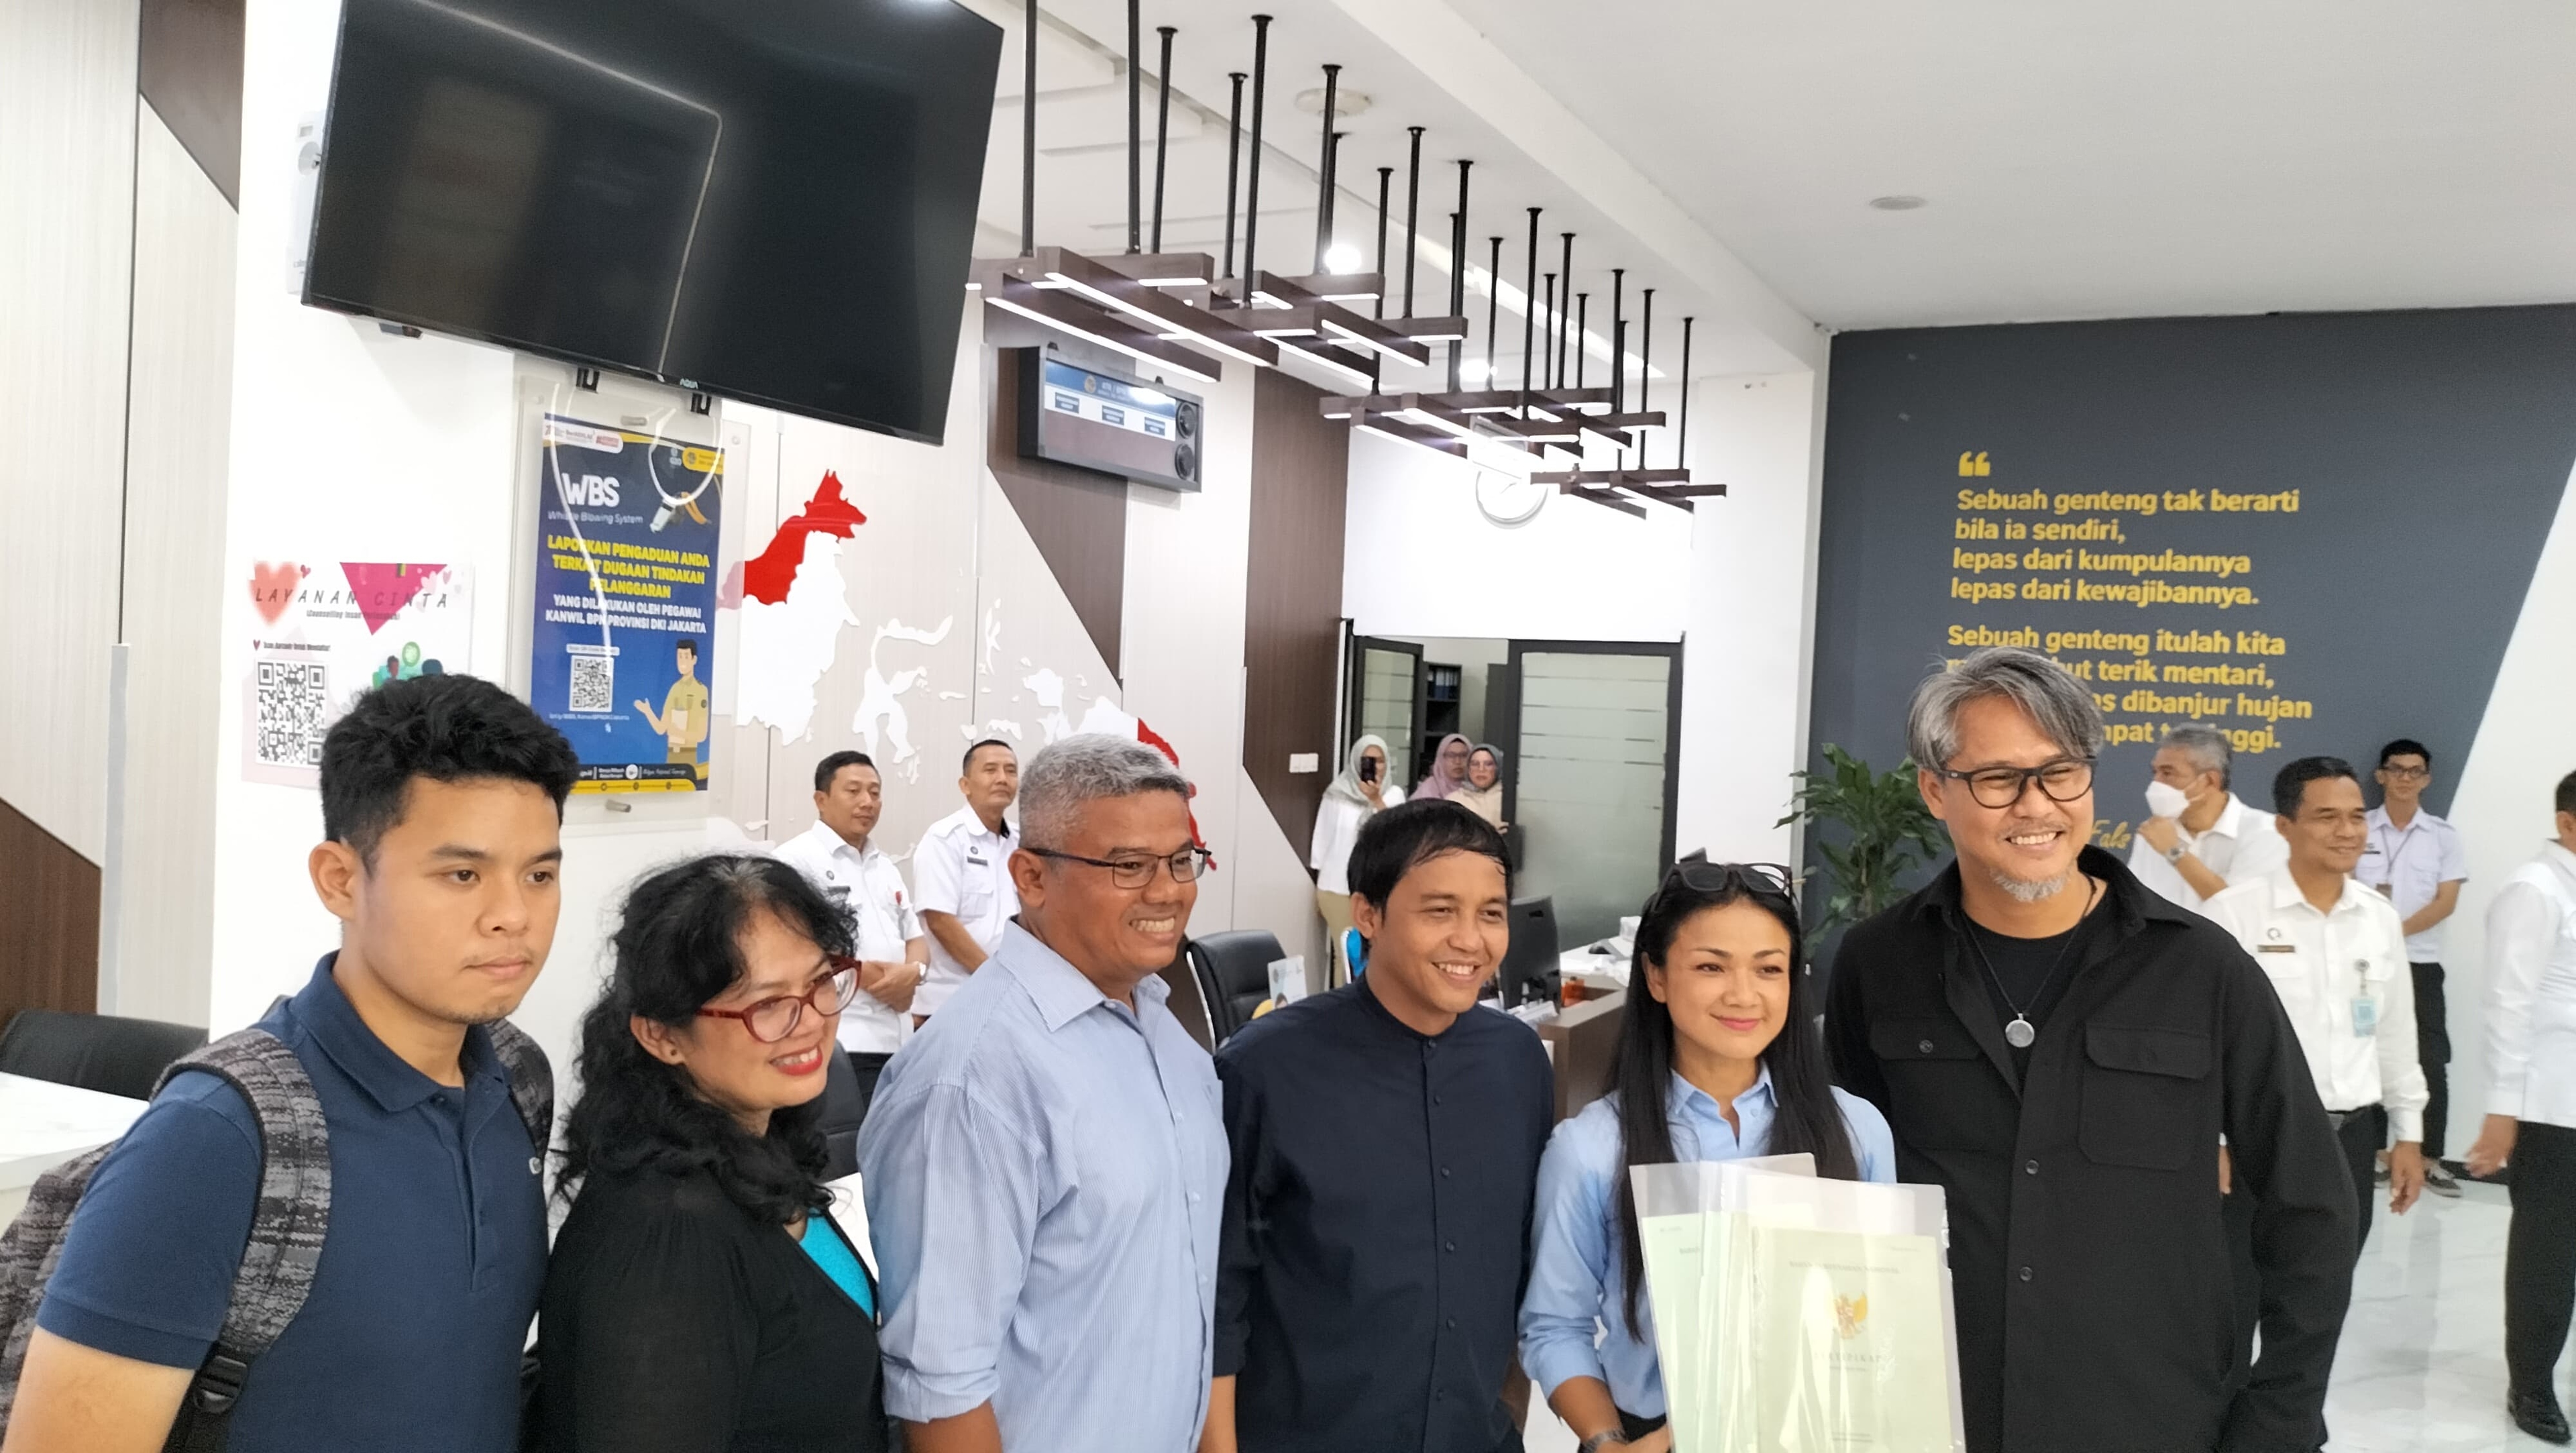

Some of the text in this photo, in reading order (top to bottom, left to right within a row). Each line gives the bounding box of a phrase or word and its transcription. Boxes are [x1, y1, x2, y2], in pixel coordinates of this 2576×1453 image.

[561, 472, 621, 508] WBS
[1957, 488, 2300, 515] Sebuah genteng tak berarti
[581, 511, 614, 525] Blowing
[615, 513, 643, 525] System
[1955, 518, 2125, 543] bila ia sendiri,
[547, 535, 710, 568] LAPOKAN PENGADUAN ANDA
[1953, 547, 2251, 578] lepas dari kumpulannya
[552, 554, 705, 584] TERKAT DUGAAN TINDAKAN
[256, 588, 447, 608] LAYANAN CINTA
[553, 594, 702, 619] YANG DILKUKAN OLEH PEGAWAI
[1951, 577, 2259, 608] lepas dari kewajibannya.
[545, 609, 586, 625] KANWIL
[608, 614, 649, 629] PROVINSI
[650, 618, 667, 631] DKI
[667, 620, 706, 634] JAKARTA
[1947, 625, 2286, 657] Sebuah genteng itulah kita
[2098, 659, 2158, 683] terik
[2163, 663, 2273, 689] mentari,
[2121, 689, 2231, 720] dibanjur
[2237, 693, 2313, 722] hujan
